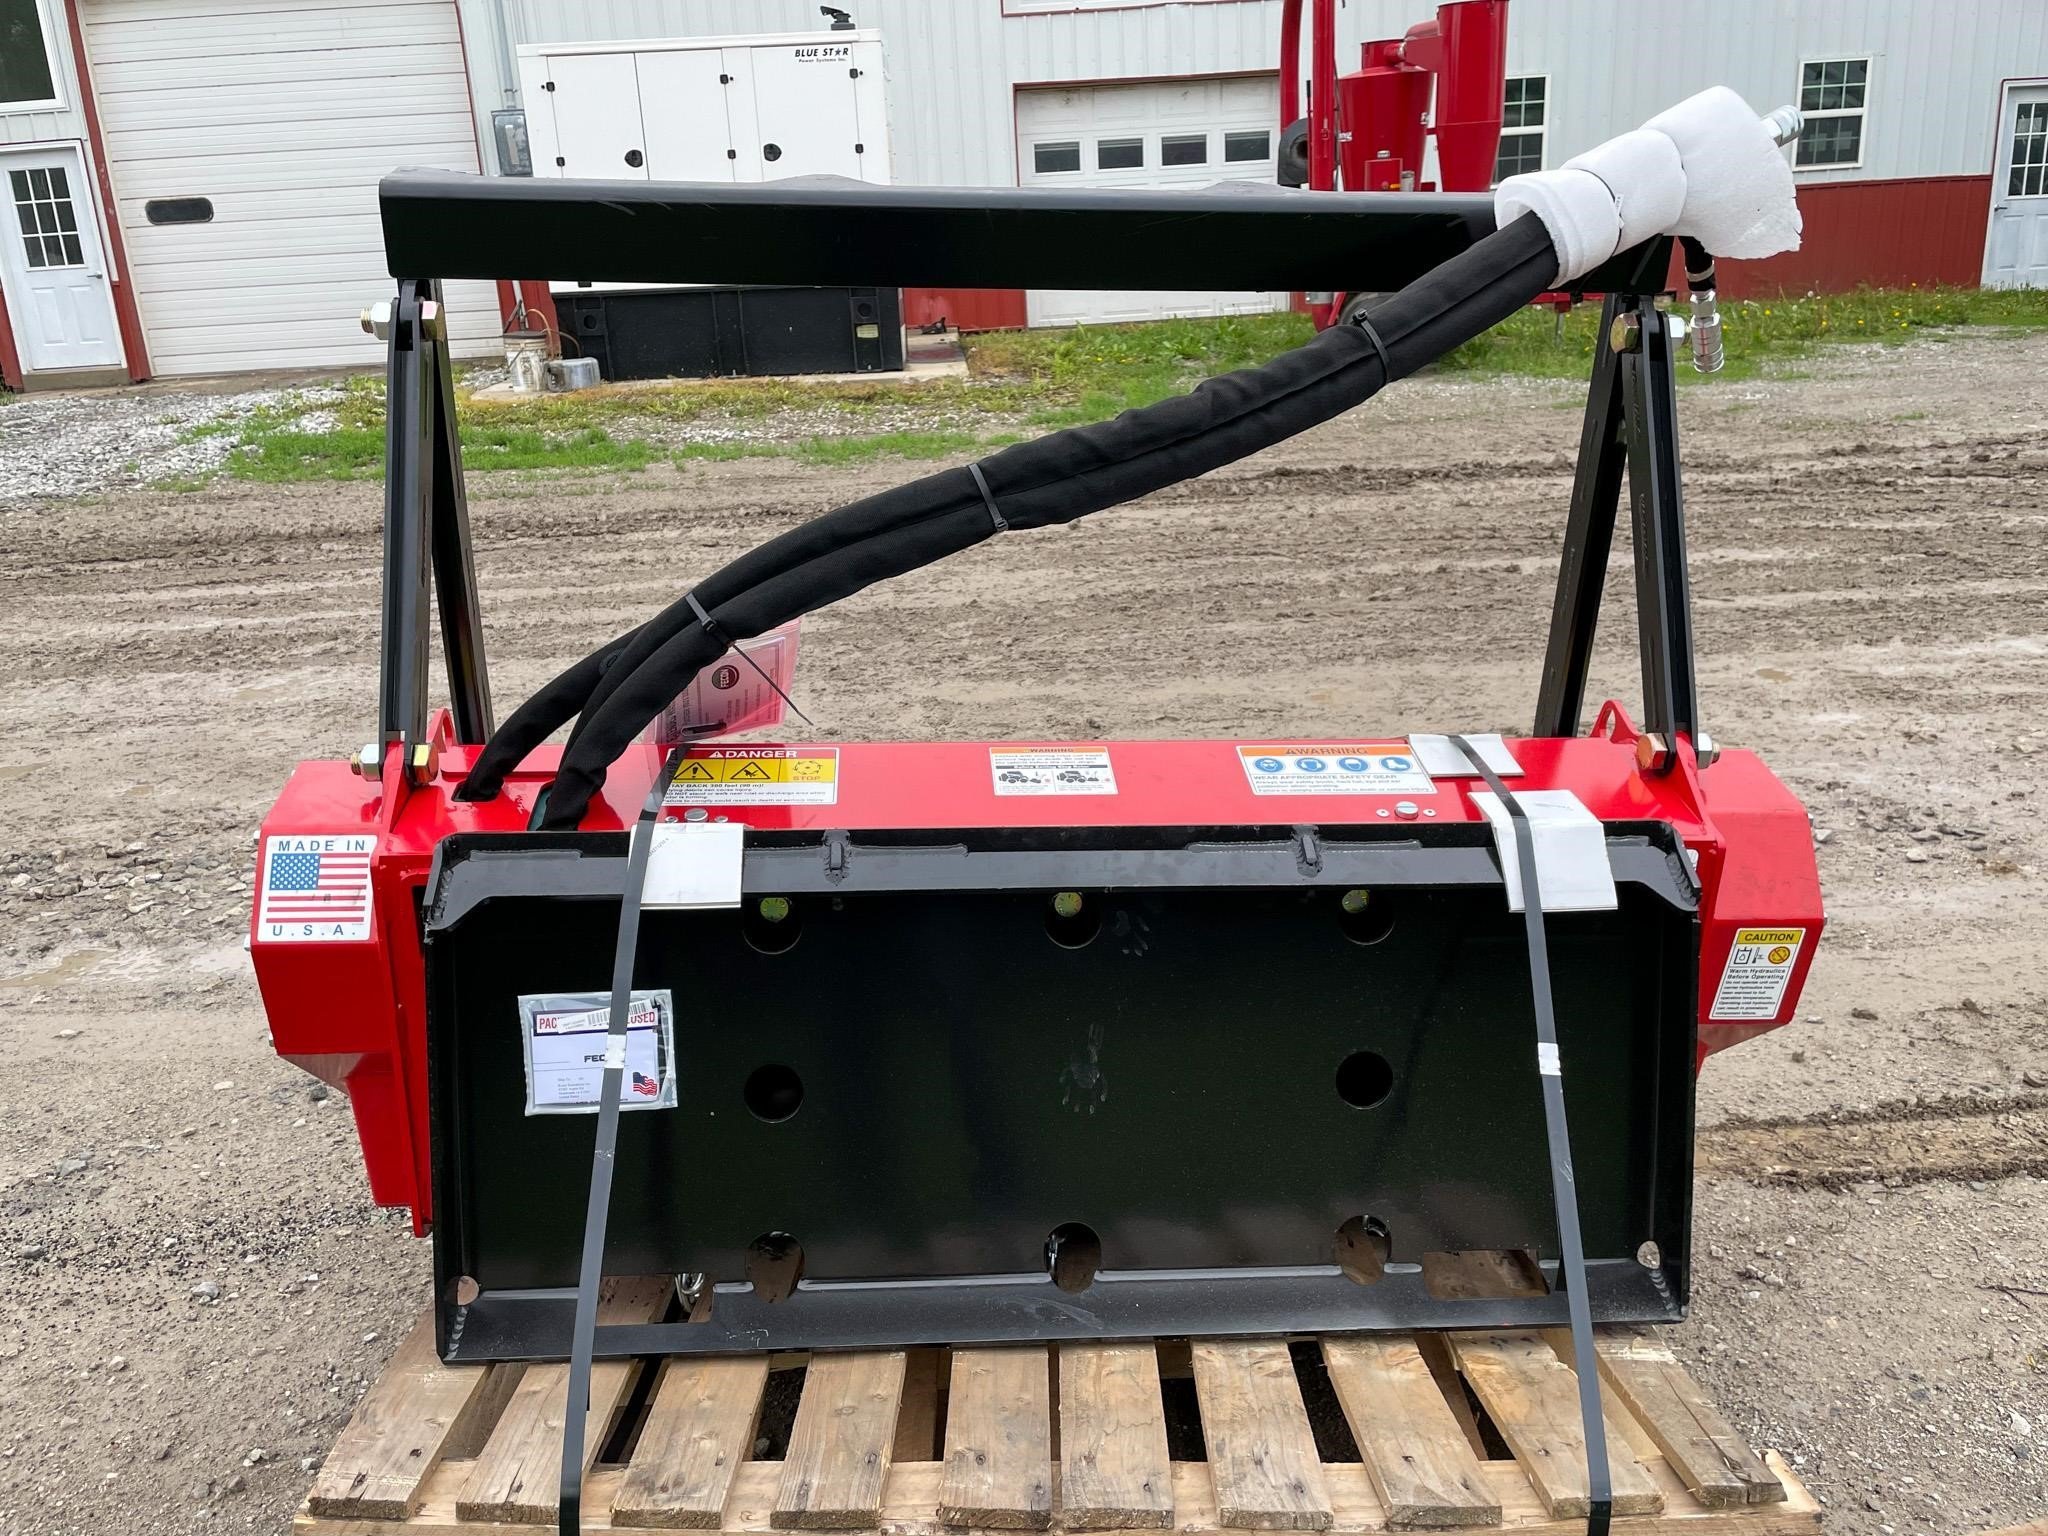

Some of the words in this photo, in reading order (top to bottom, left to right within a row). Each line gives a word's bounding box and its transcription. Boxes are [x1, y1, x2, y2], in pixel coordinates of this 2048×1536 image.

[795, 48, 819, 57] BLUE
[725, 750, 798, 759] DANGER
[1295, 747, 1369, 755] WARNING
[278, 840, 334, 852] MADE
[346, 840, 365, 851] IN
[1744, 933, 1795, 942] CAUTION
[584, 1054, 606, 1062] FEC
